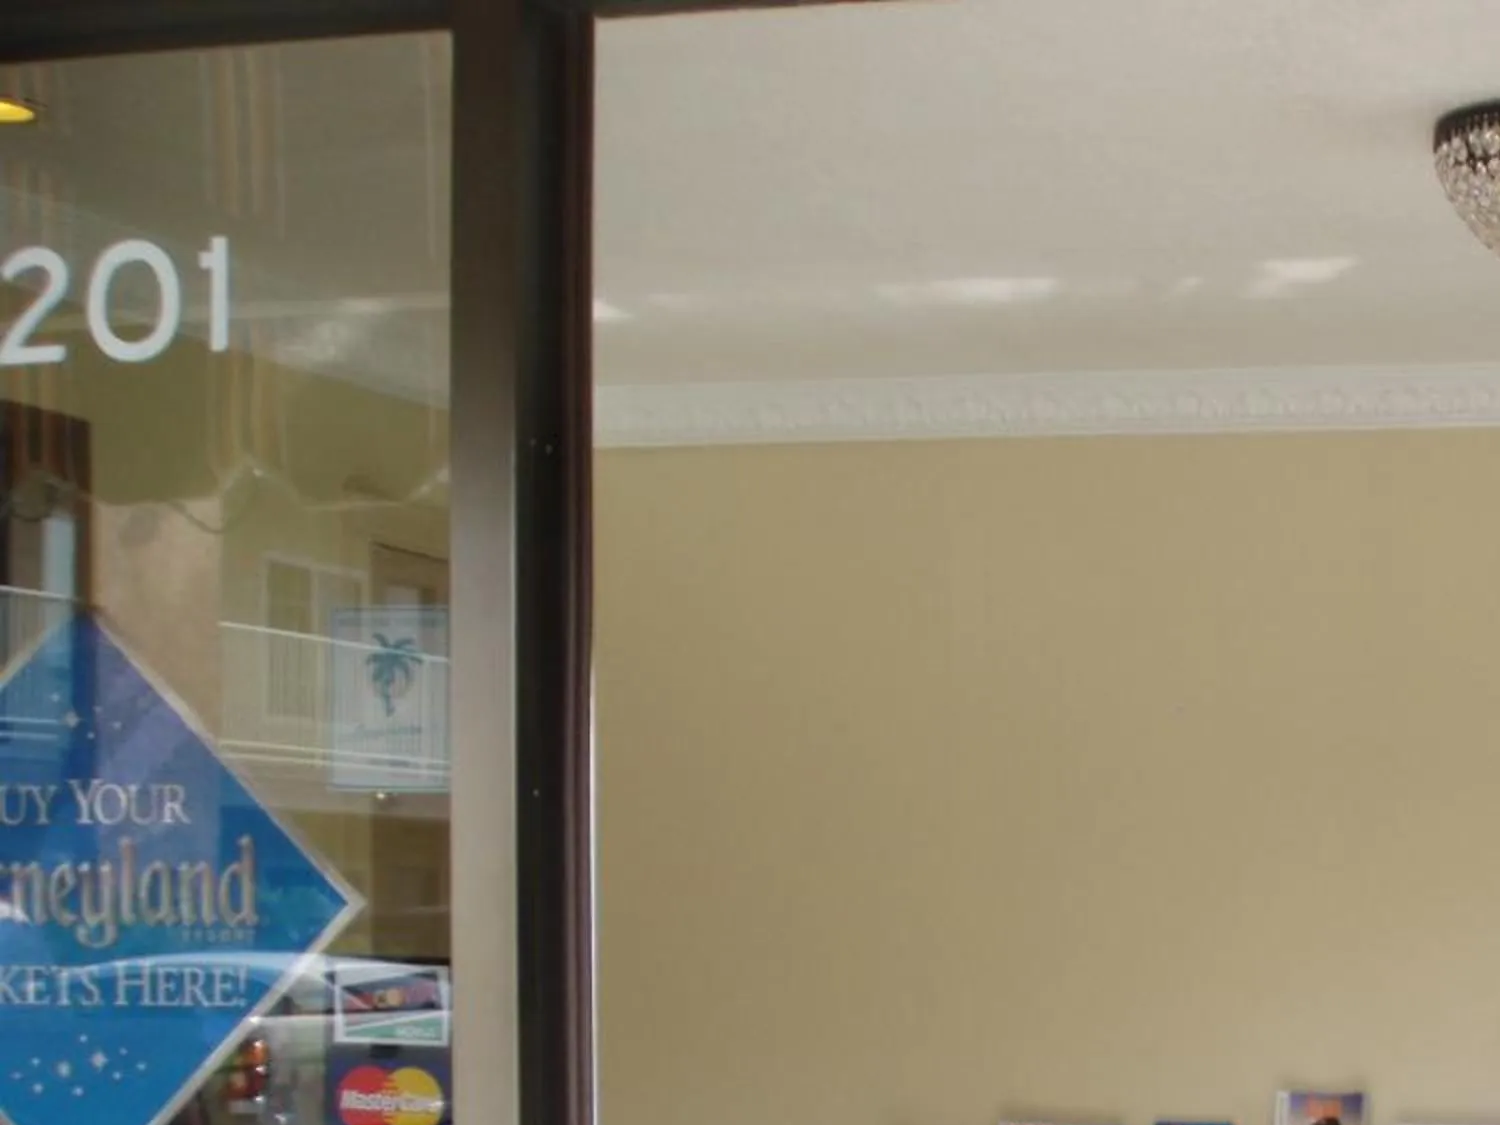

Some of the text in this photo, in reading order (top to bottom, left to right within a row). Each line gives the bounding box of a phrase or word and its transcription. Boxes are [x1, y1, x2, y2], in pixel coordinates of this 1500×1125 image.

[0, 235, 229, 366] 201
[68, 778, 192, 825] YOUR
[0, 836, 258, 948] neyland
[112, 960, 249, 1008] HERE!
